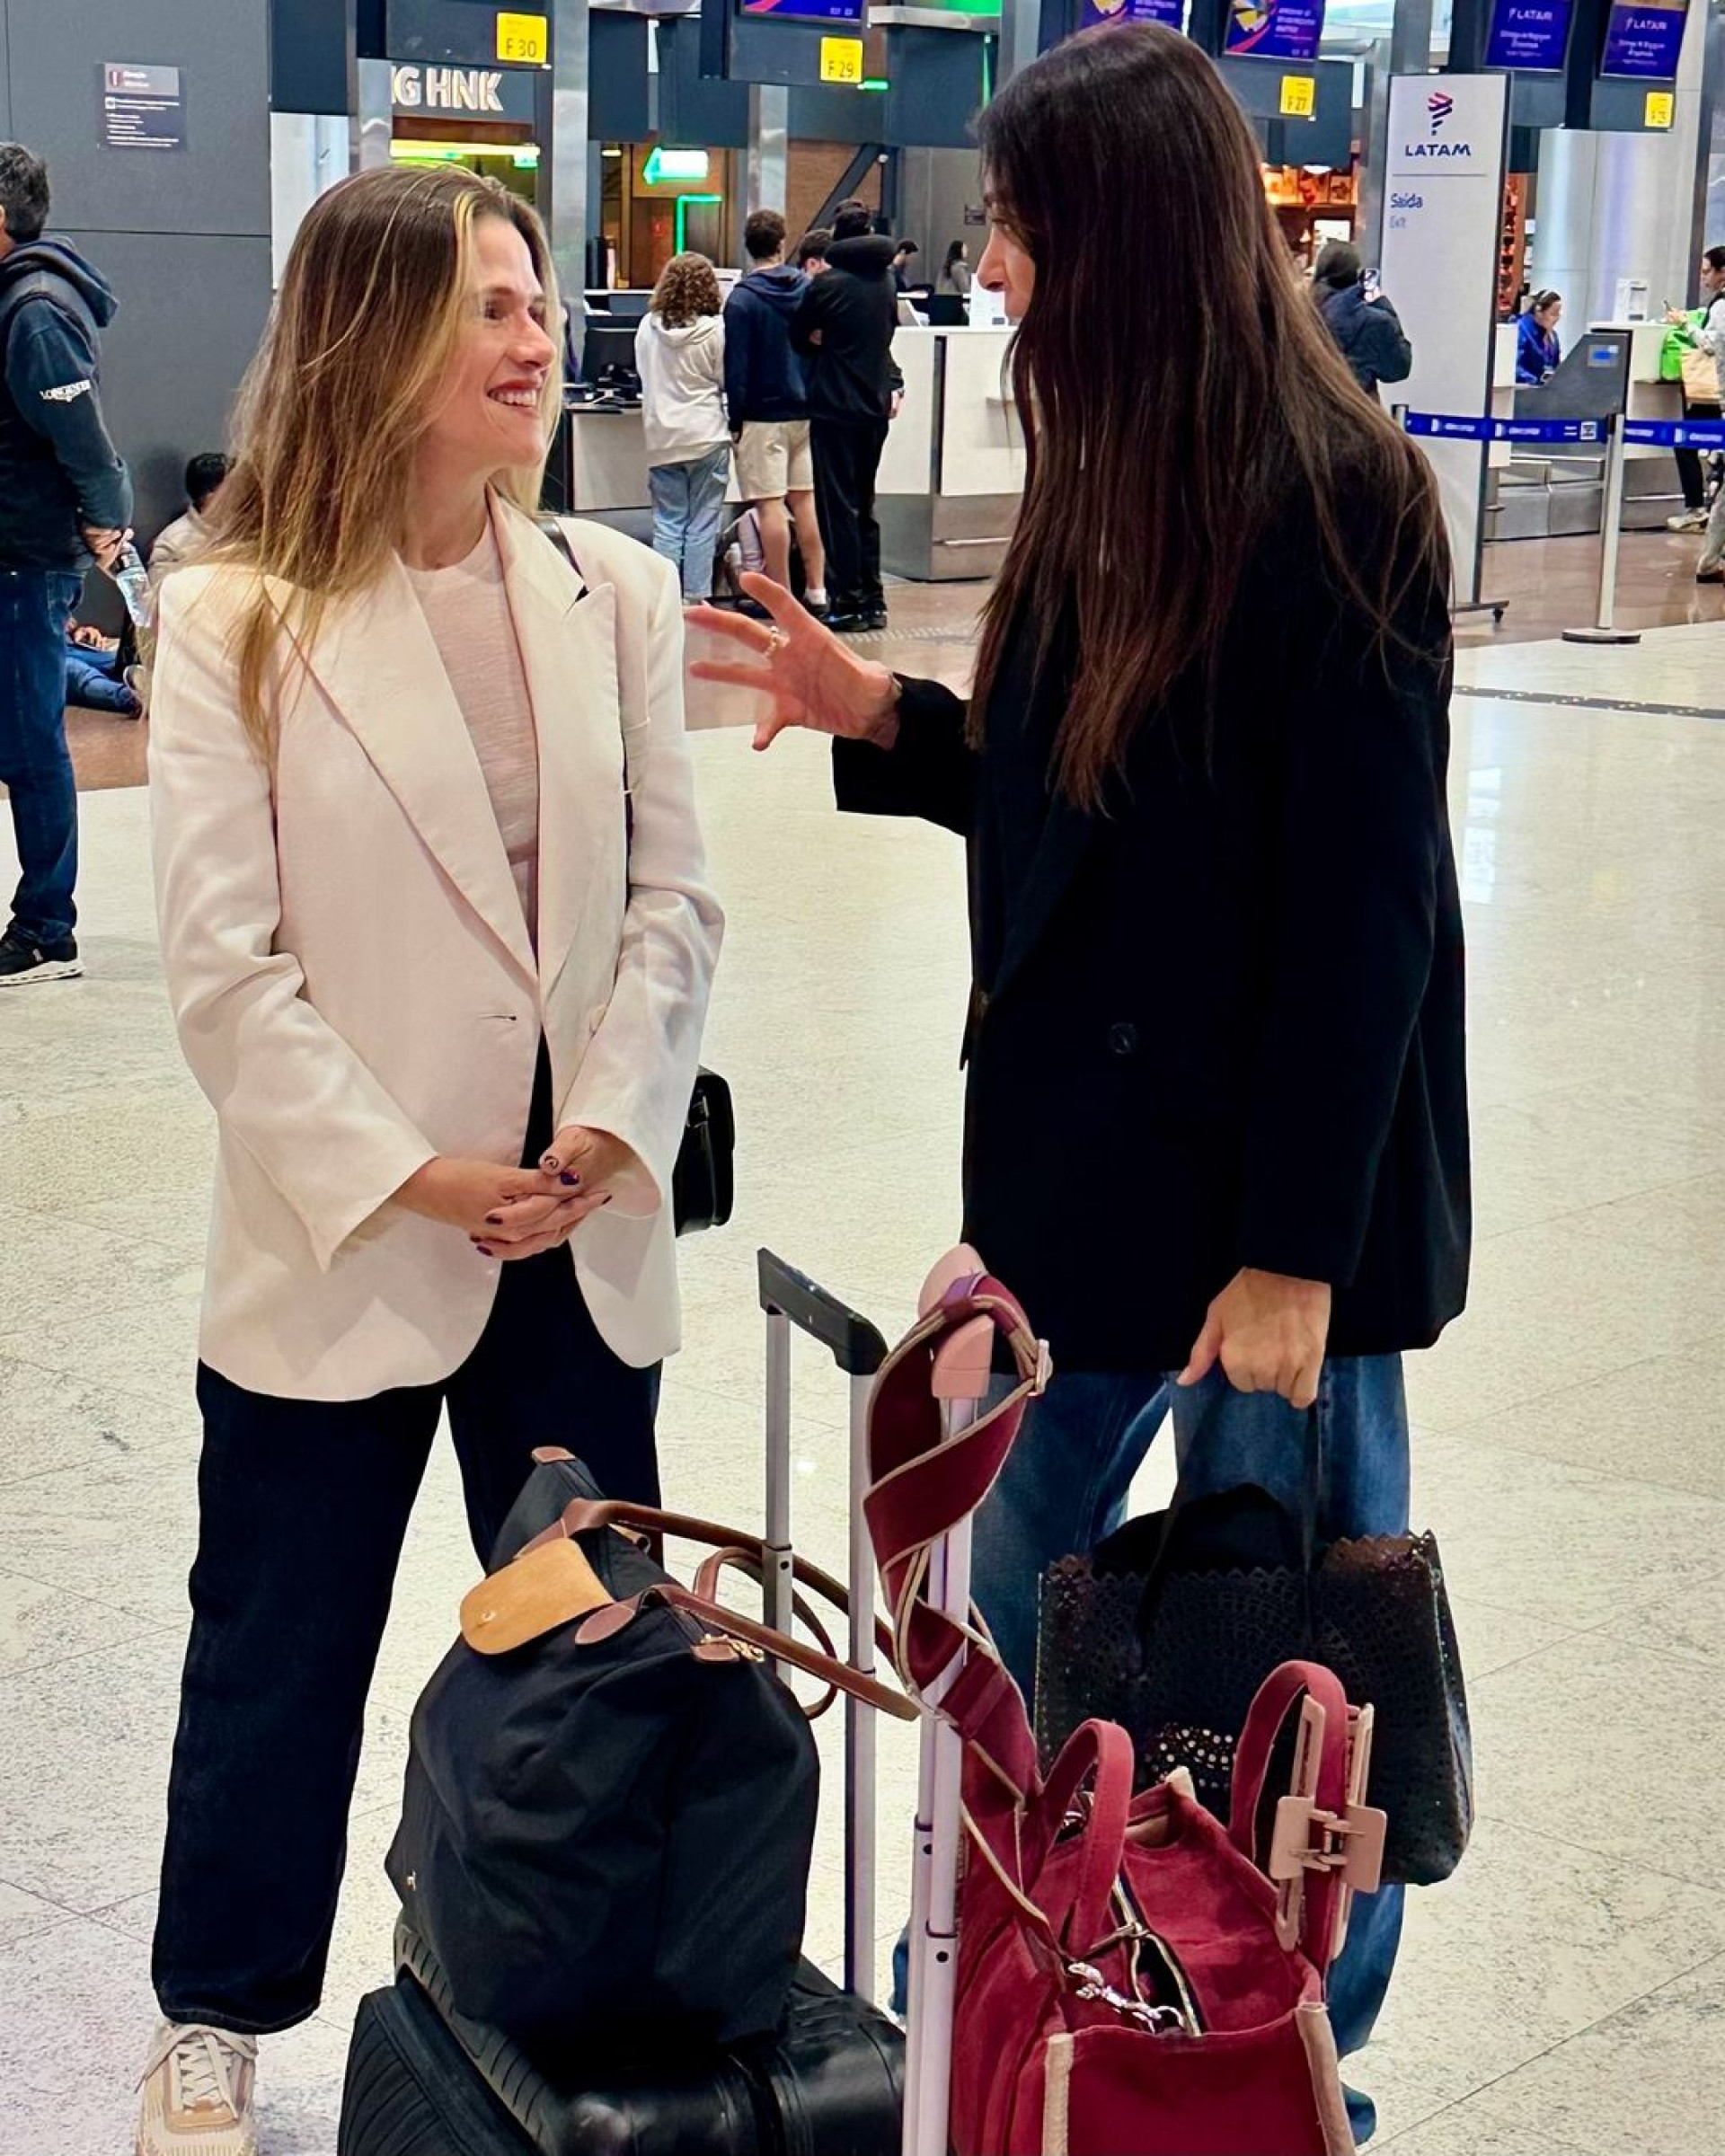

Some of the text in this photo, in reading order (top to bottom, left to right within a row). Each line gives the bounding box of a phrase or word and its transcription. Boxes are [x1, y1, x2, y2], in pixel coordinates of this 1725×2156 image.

[505, 37, 537, 57] F 30
[827, 59, 854, 78] F 29
[426, 67, 504, 111] HNK
[1405, 144, 1471, 156] LATAM
[1390, 192, 1424, 208] Saída
